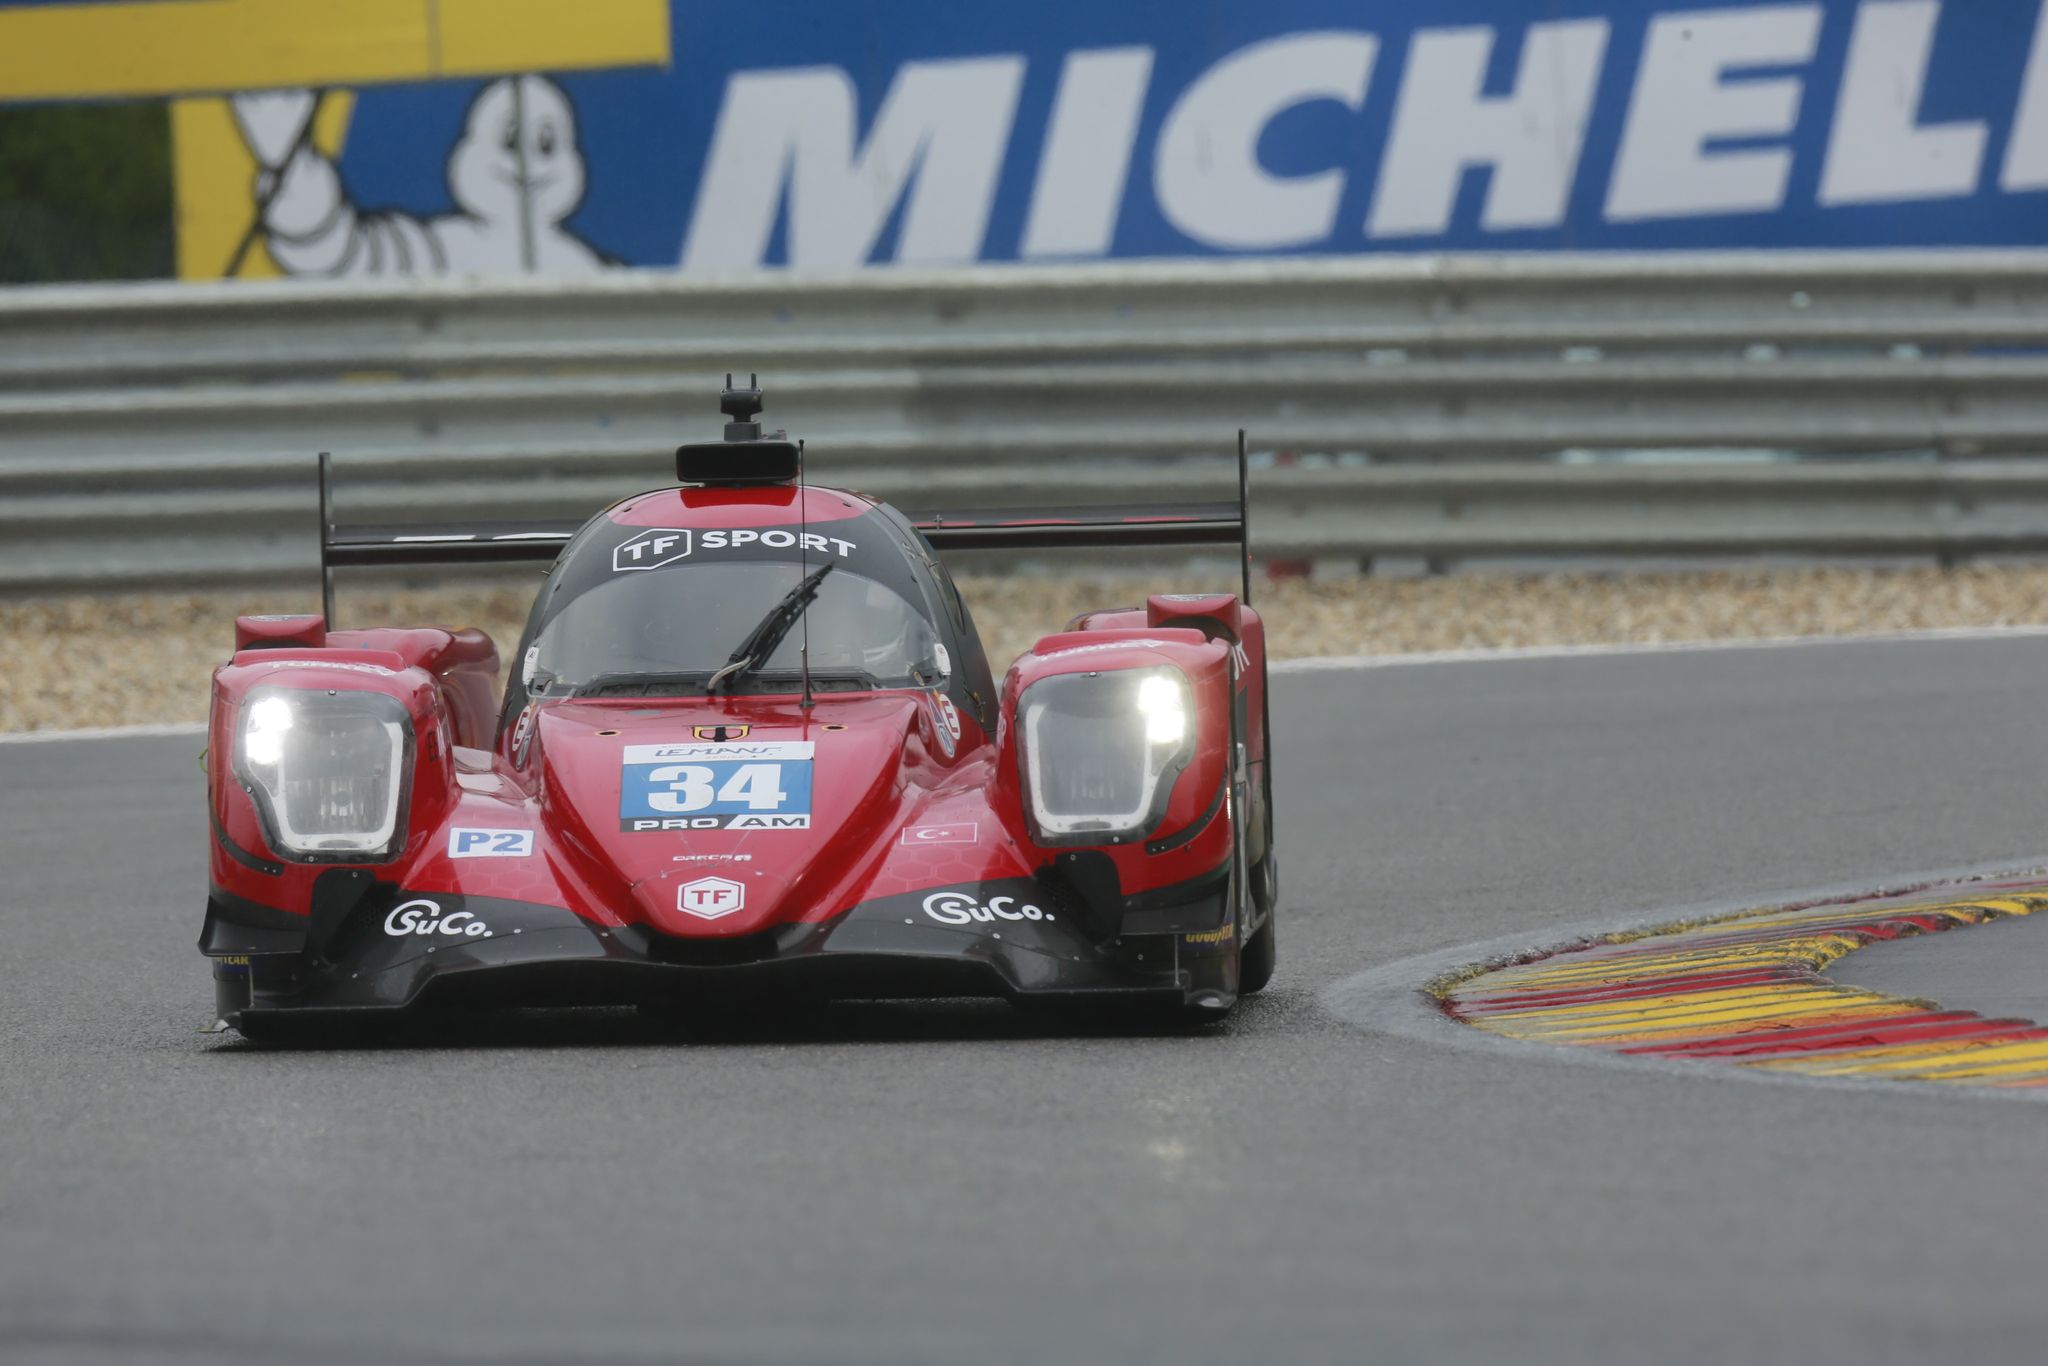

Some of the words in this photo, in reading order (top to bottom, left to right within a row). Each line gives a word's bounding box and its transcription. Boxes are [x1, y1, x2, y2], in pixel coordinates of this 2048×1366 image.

[681, 0, 2048, 270] MICHEL
[624, 536, 679, 560] TF
[701, 530, 856, 557] SPORT
[648, 764, 787, 812] 34
[634, 818, 719, 831] PRO
[741, 817, 806, 827] AM
[458, 832, 525, 852] P2
[691, 890, 732, 904] TF
